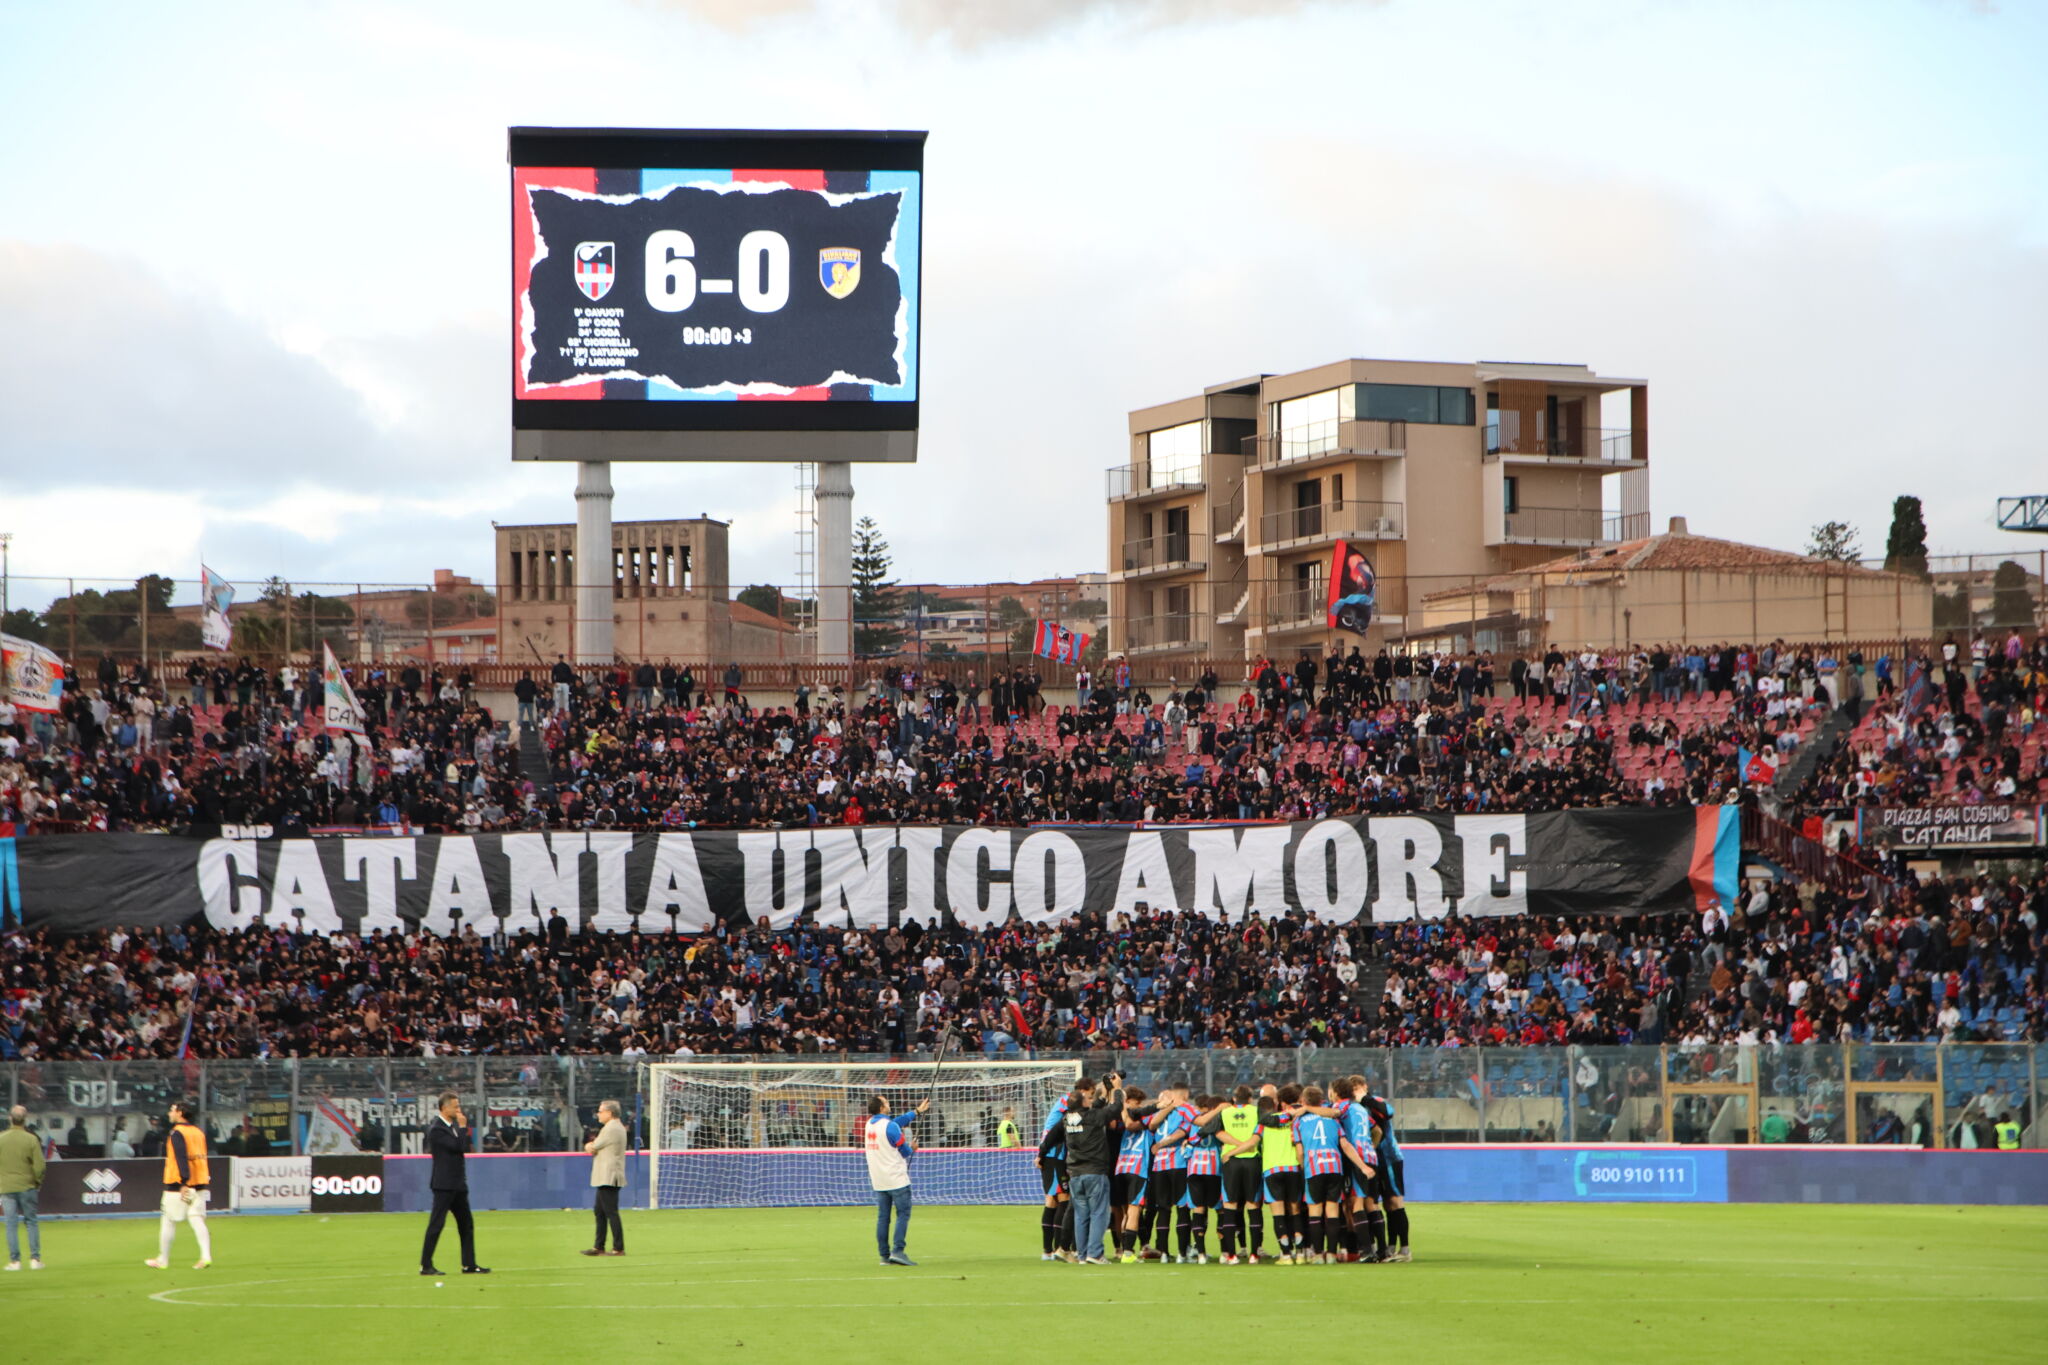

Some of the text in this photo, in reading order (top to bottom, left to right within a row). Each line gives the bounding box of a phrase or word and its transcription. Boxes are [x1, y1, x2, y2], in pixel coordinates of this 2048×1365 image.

[593, 317, 620, 328] CODA
[593, 327, 620, 338] CODA
[683, 326, 732, 345] 90:00
[588, 357, 625, 367] LIGUORI
[589, 347, 639, 358] CATURANO
[1935, 806, 1959, 824] SAN
[1962, 804, 2011, 823] COSIMO
[1902, 825, 1992, 844] CATANIA
[197, 813, 1528, 937] CATANIA UNICO AMORE
[1312, 1120, 1327, 1146] 4
[1591, 1167, 1685, 1183] 800 910 111
[312, 1175, 382, 1195] 90:00
